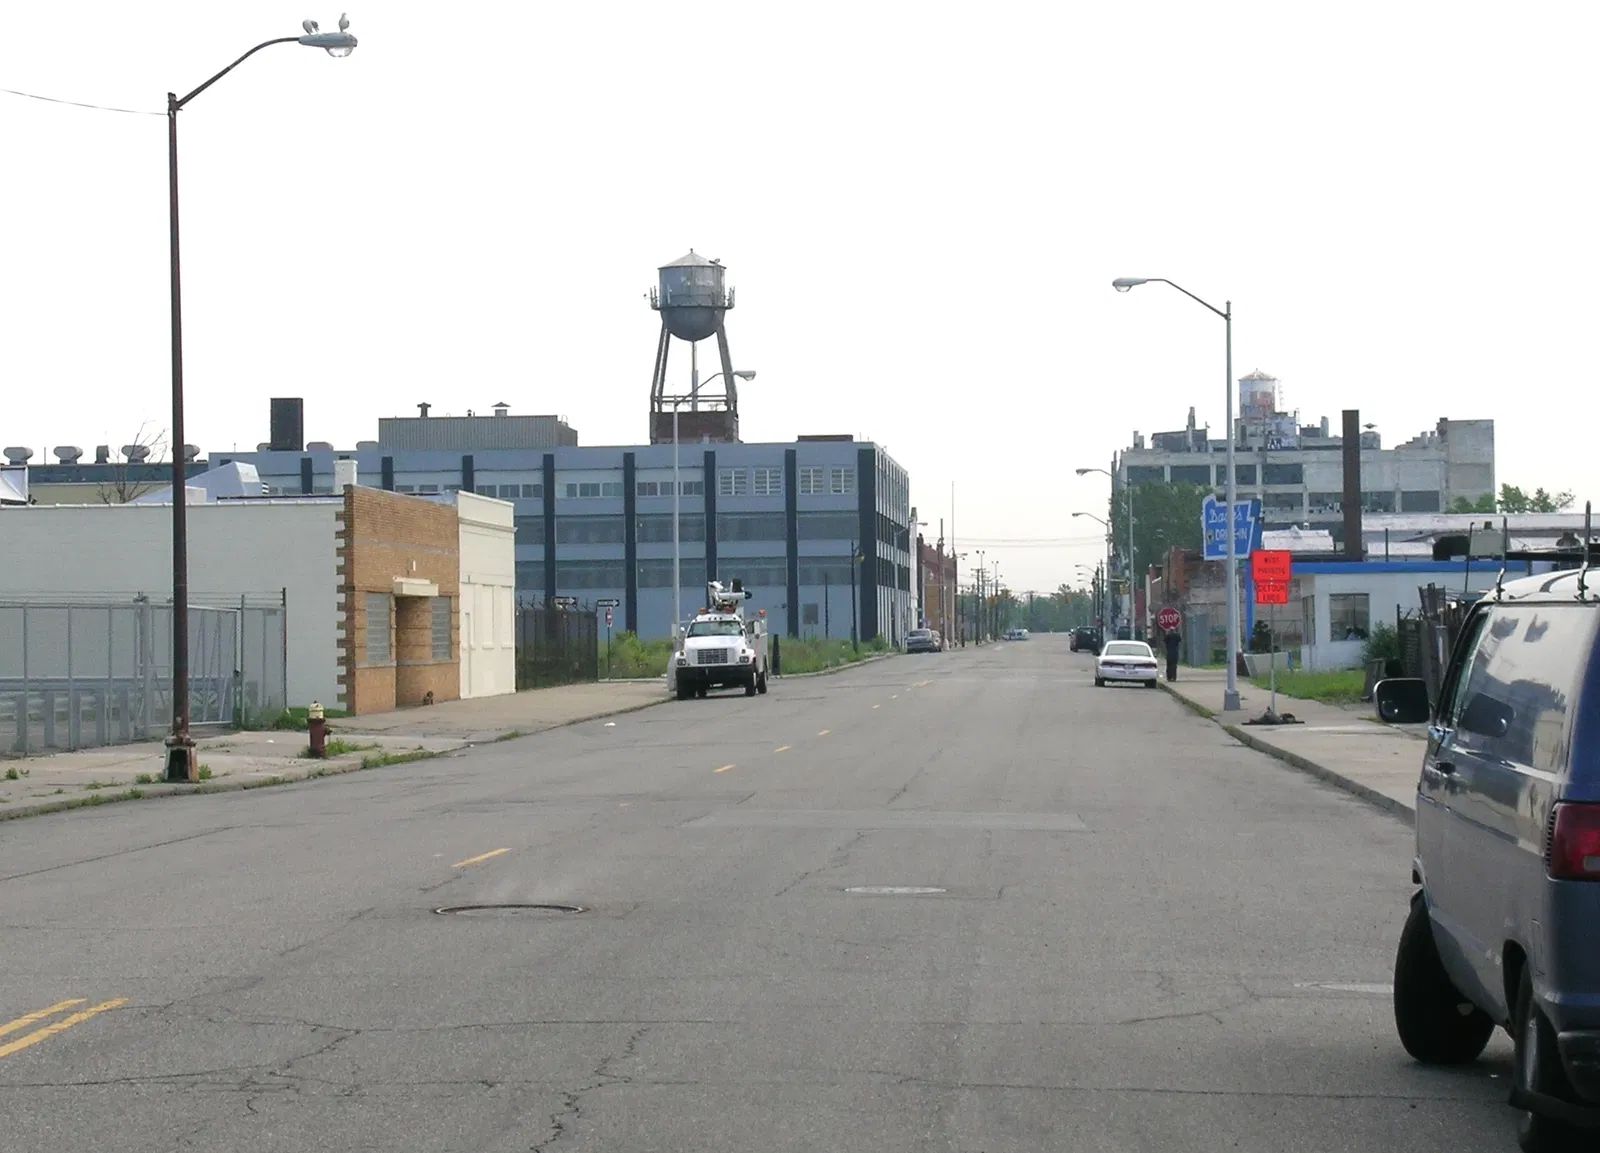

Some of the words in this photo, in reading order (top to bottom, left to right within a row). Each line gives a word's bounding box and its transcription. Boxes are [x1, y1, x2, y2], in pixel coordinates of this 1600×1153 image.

[1209, 505, 1243, 523] Dae's
[1215, 528, 1248, 540] DRIE-IN
[1258, 584, 1287, 593] DETOUR
[1159, 613, 1179, 624] STOP
